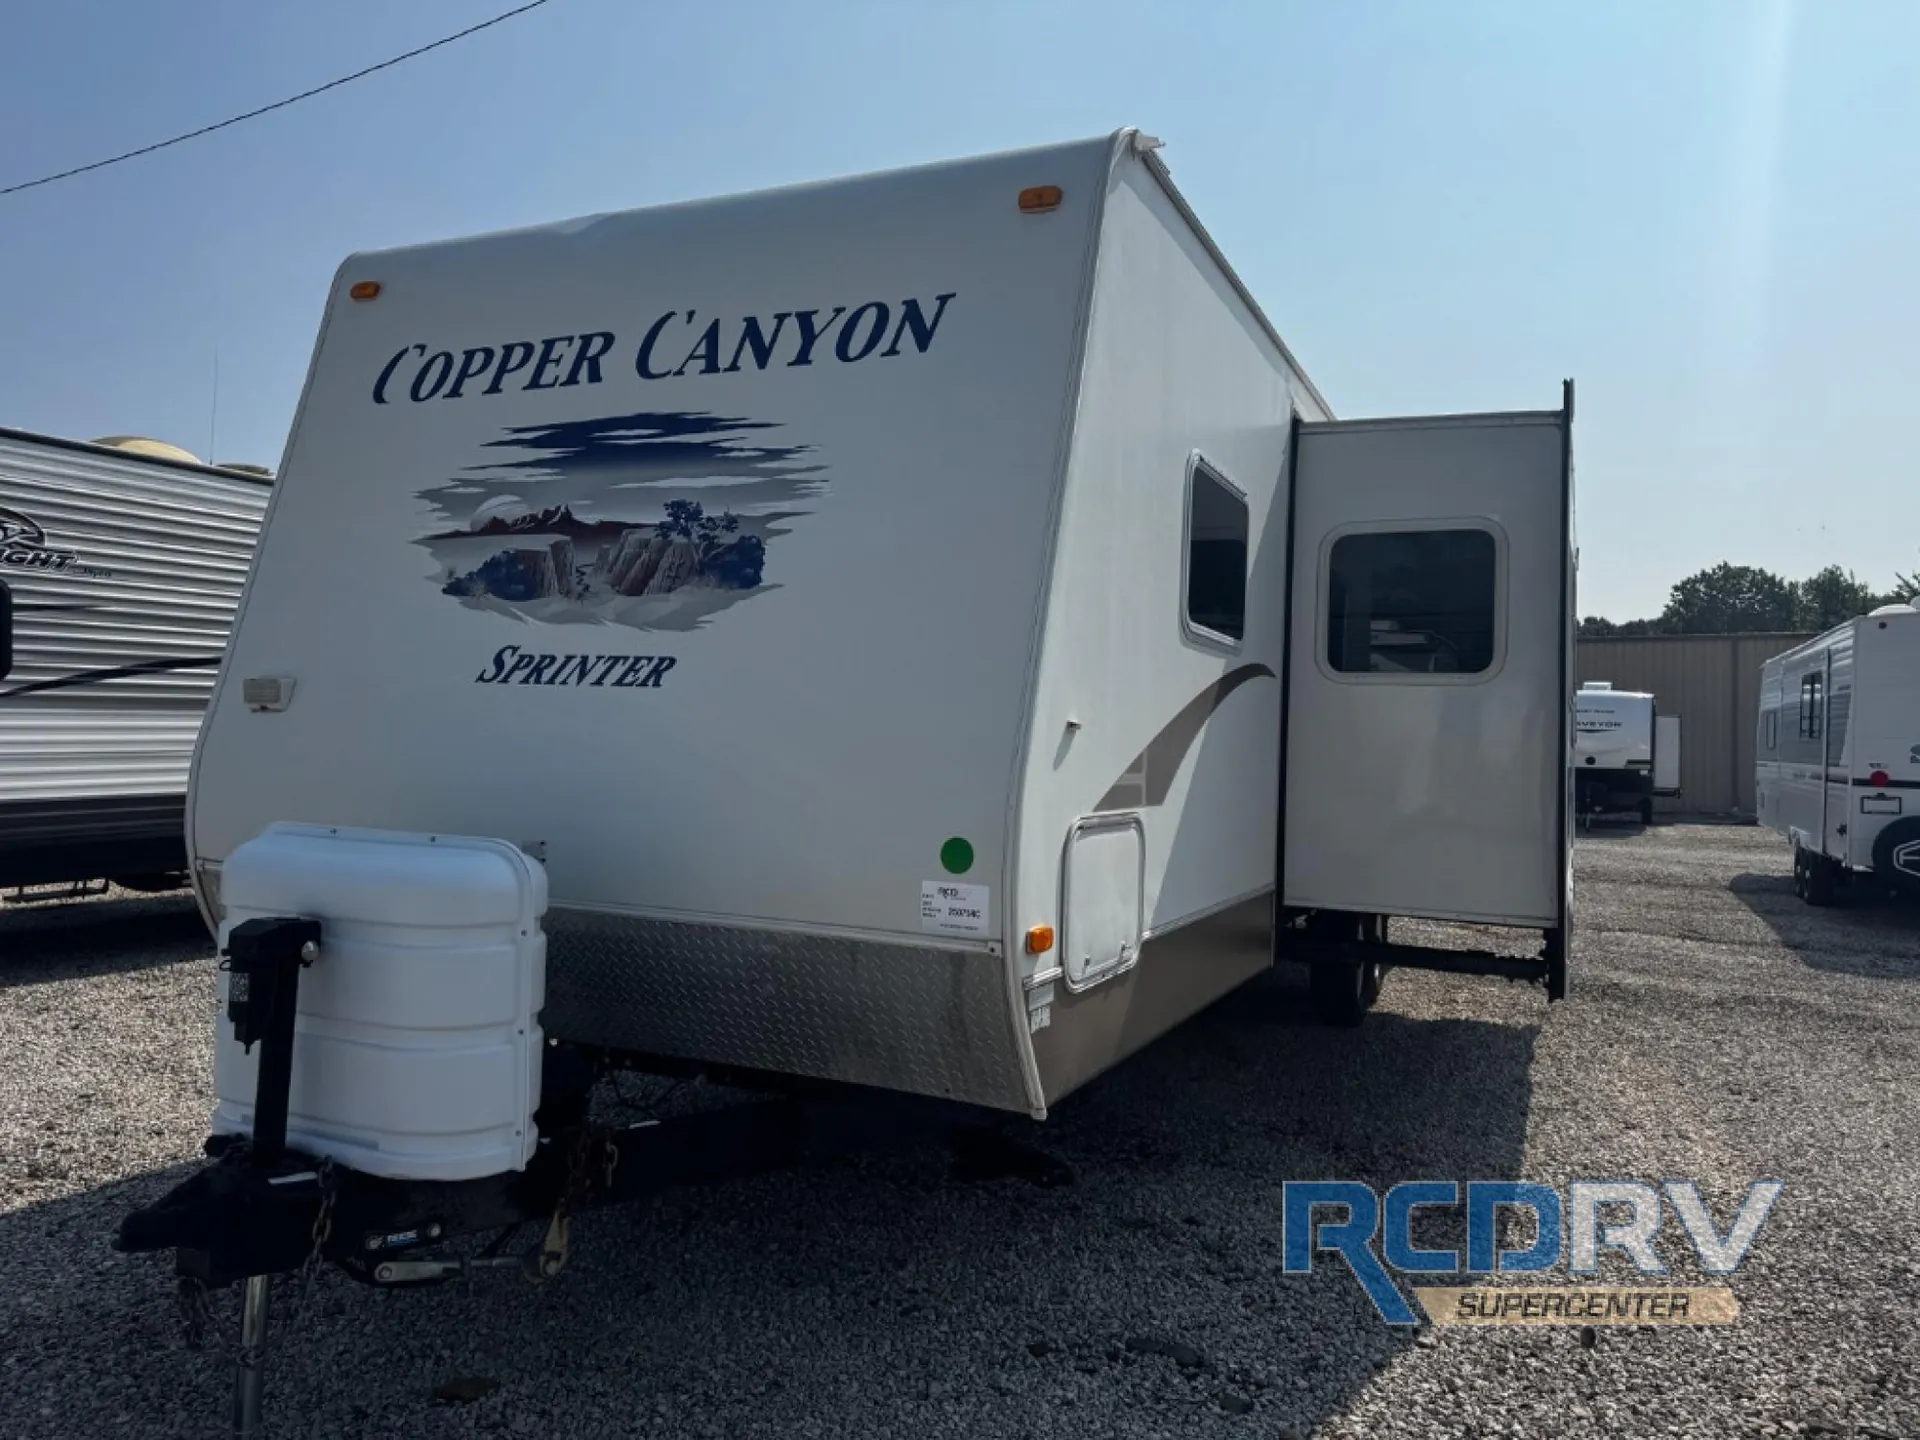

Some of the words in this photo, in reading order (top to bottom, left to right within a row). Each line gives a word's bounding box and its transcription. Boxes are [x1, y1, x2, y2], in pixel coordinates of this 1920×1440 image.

[373, 328, 616, 405] COPPER
[634, 292, 957, 381] CANYON
[0, 550, 78, 569] GHT
[475, 645, 677, 688] SPRINTER
